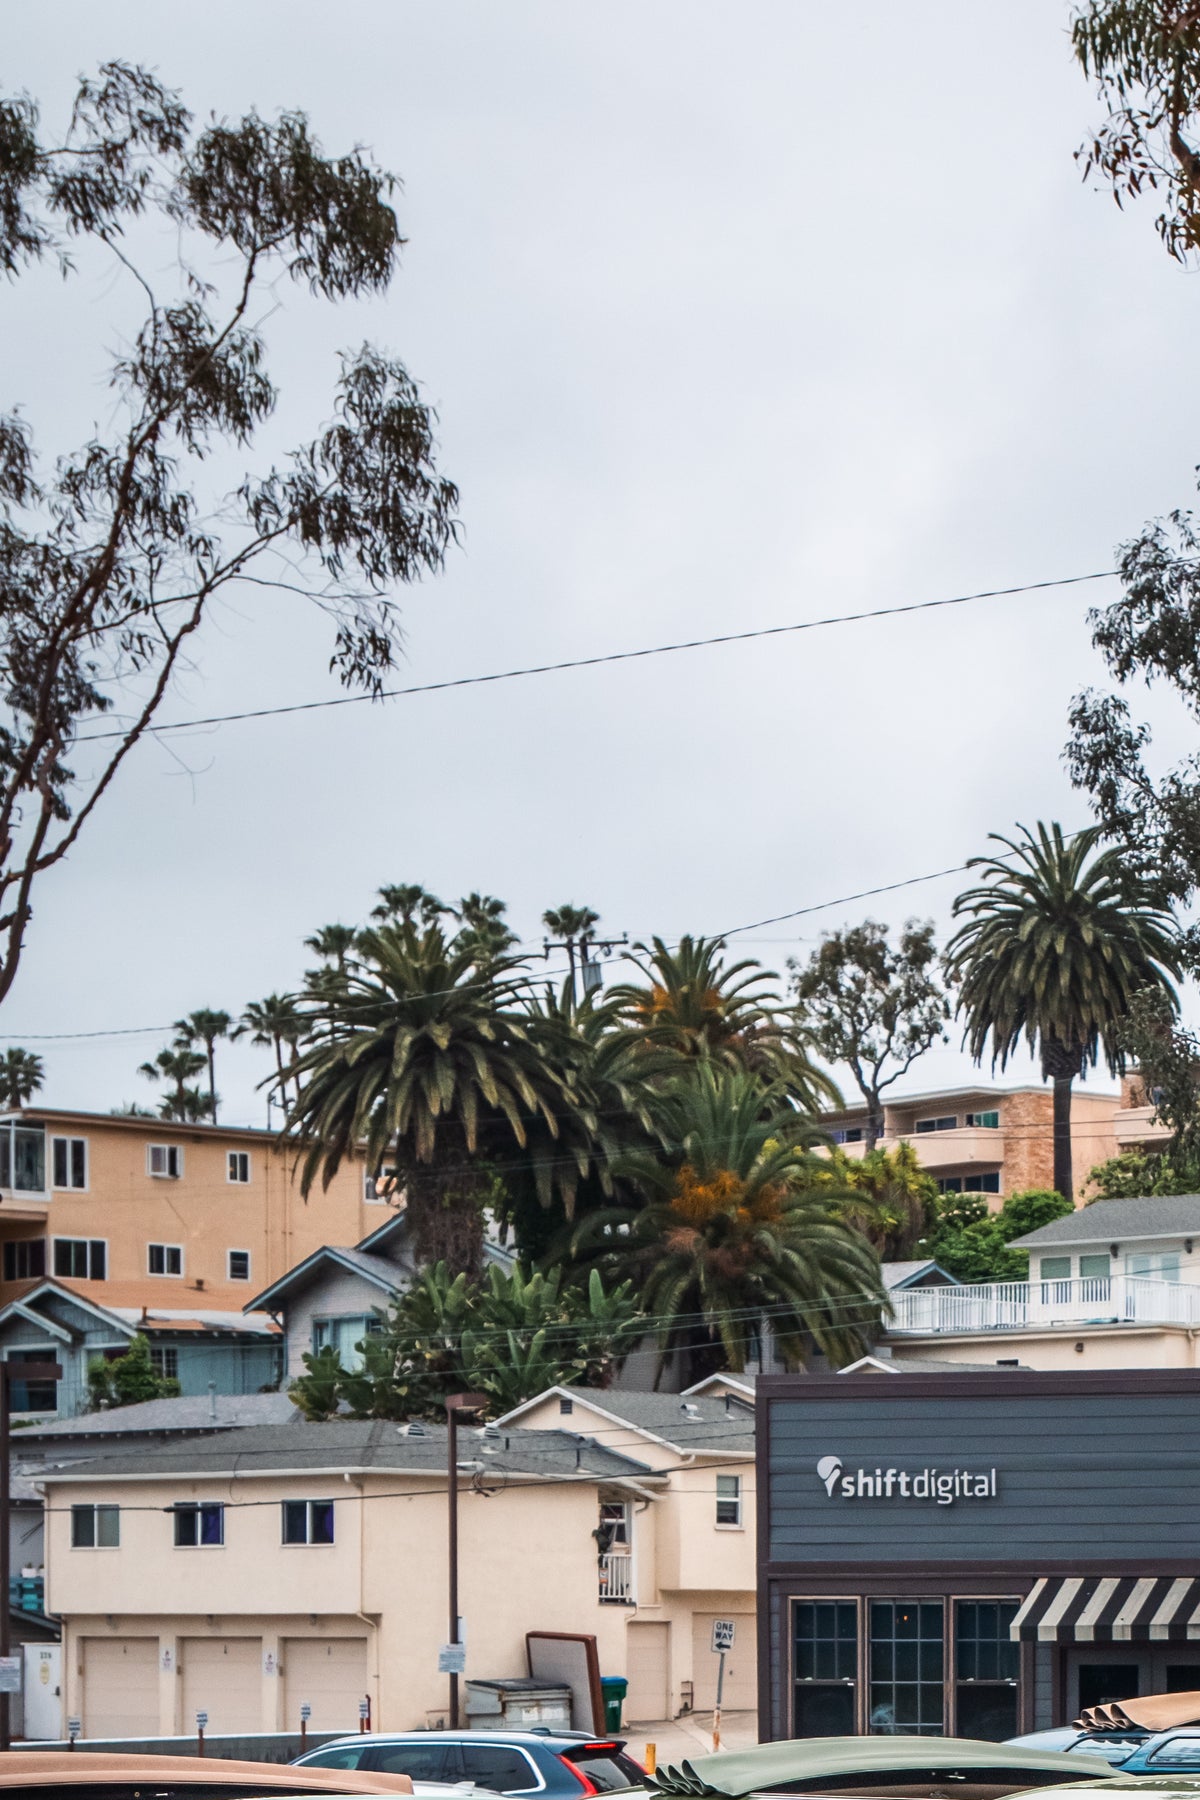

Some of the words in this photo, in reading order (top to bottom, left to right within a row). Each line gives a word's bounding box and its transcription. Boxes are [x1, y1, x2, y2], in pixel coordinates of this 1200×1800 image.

[841, 1468, 997, 1504] shiftdigital
[716, 1622, 733, 1631] ONE
[715, 1632, 733, 1640] WAY
